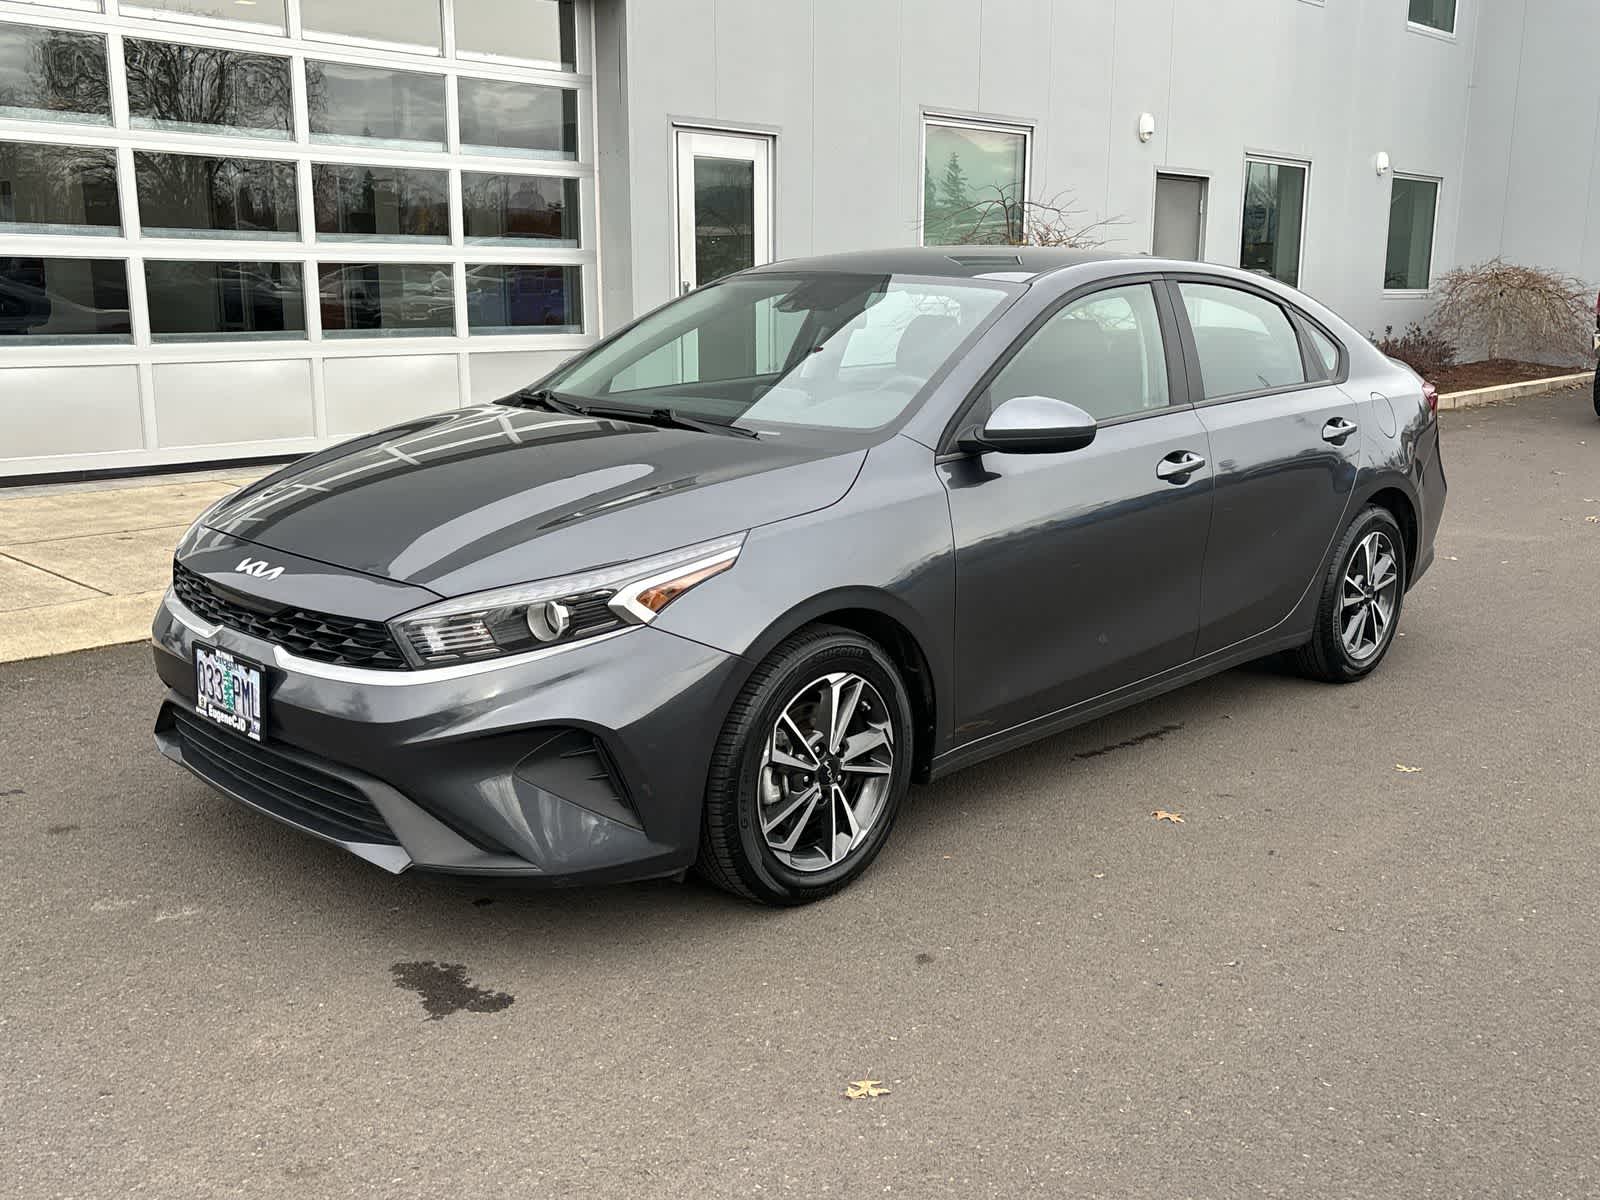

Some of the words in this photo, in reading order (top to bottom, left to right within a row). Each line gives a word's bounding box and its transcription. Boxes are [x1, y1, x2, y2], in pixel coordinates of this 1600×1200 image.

[235, 557, 285, 580] KIA
[198, 660, 223, 704] 033
[232, 674, 260, 720] PML
